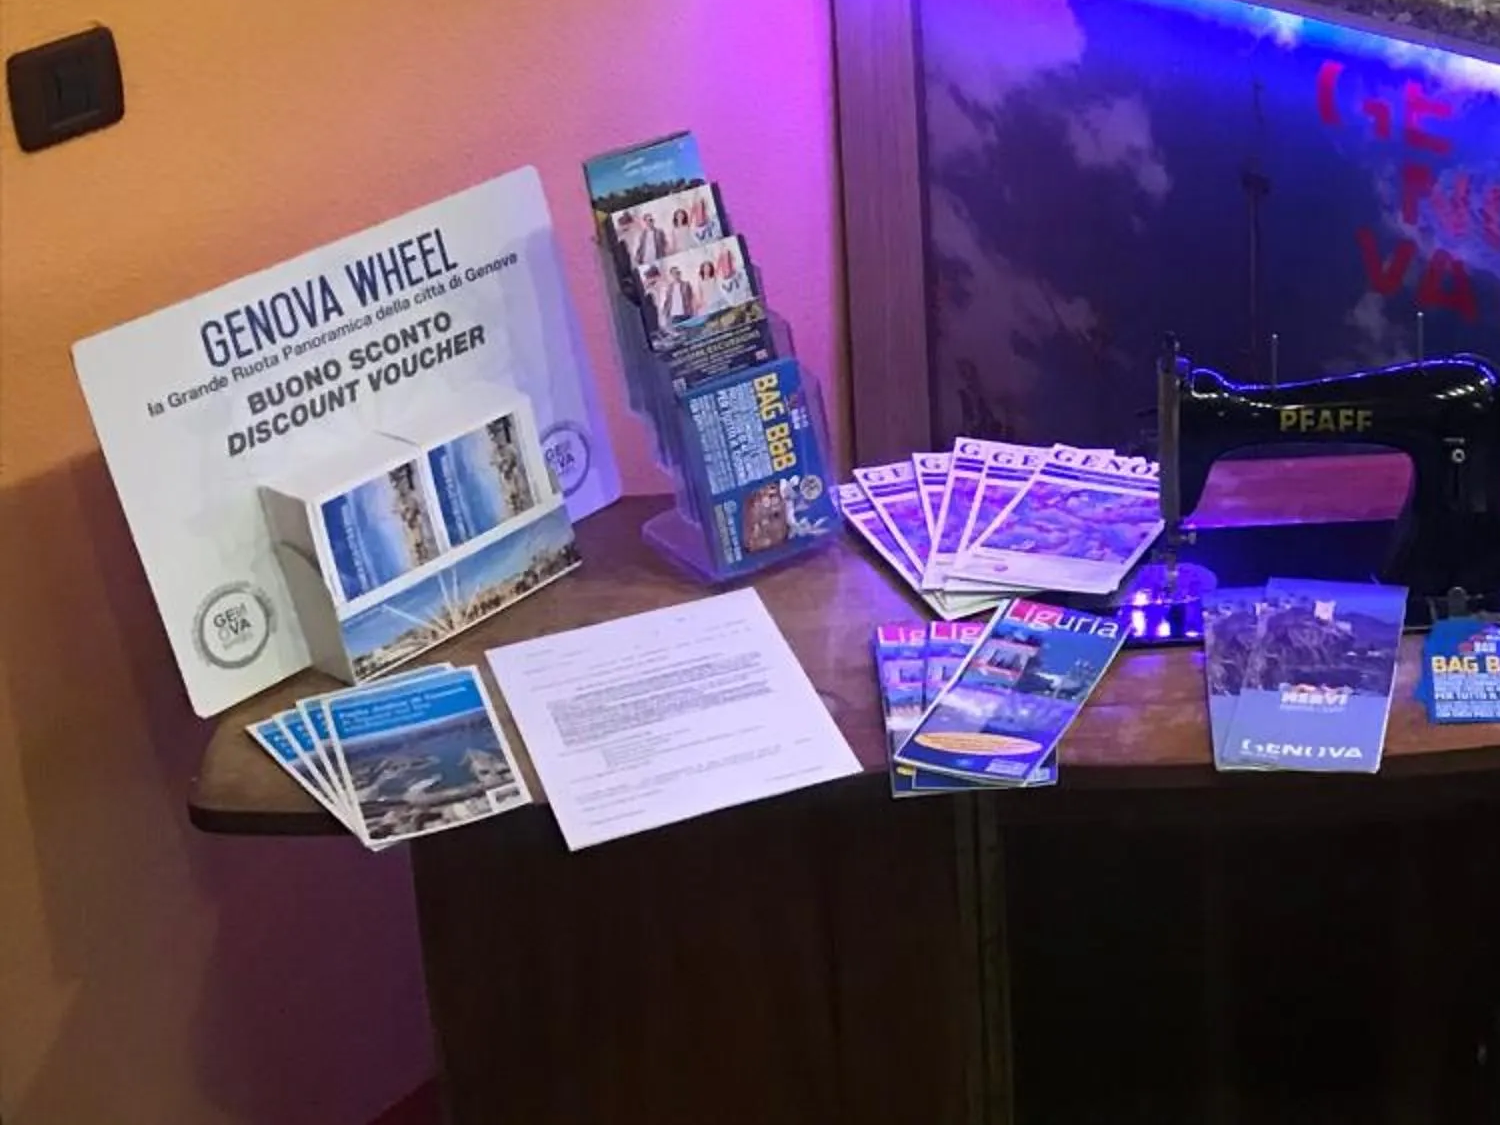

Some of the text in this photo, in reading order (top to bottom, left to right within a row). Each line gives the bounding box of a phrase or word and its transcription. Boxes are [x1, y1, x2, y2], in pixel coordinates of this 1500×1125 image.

[200, 228, 459, 368] GENOVA WHEEL
[147, 251, 519, 418] la Grande Ruota Panoramica della città di Genova
[247, 310, 453, 416] BUONO SCONTO
[227, 323, 486, 458] DISCOUNT VOUCHER
[752, 372, 786, 423] BAG
[1279, 408, 1373, 433] PFAFF
[1004, 596, 1121, 639] Liguria
[1431, 655, 1478, 673] BAG
[1241, 738, 1363, 759] GENOVA
